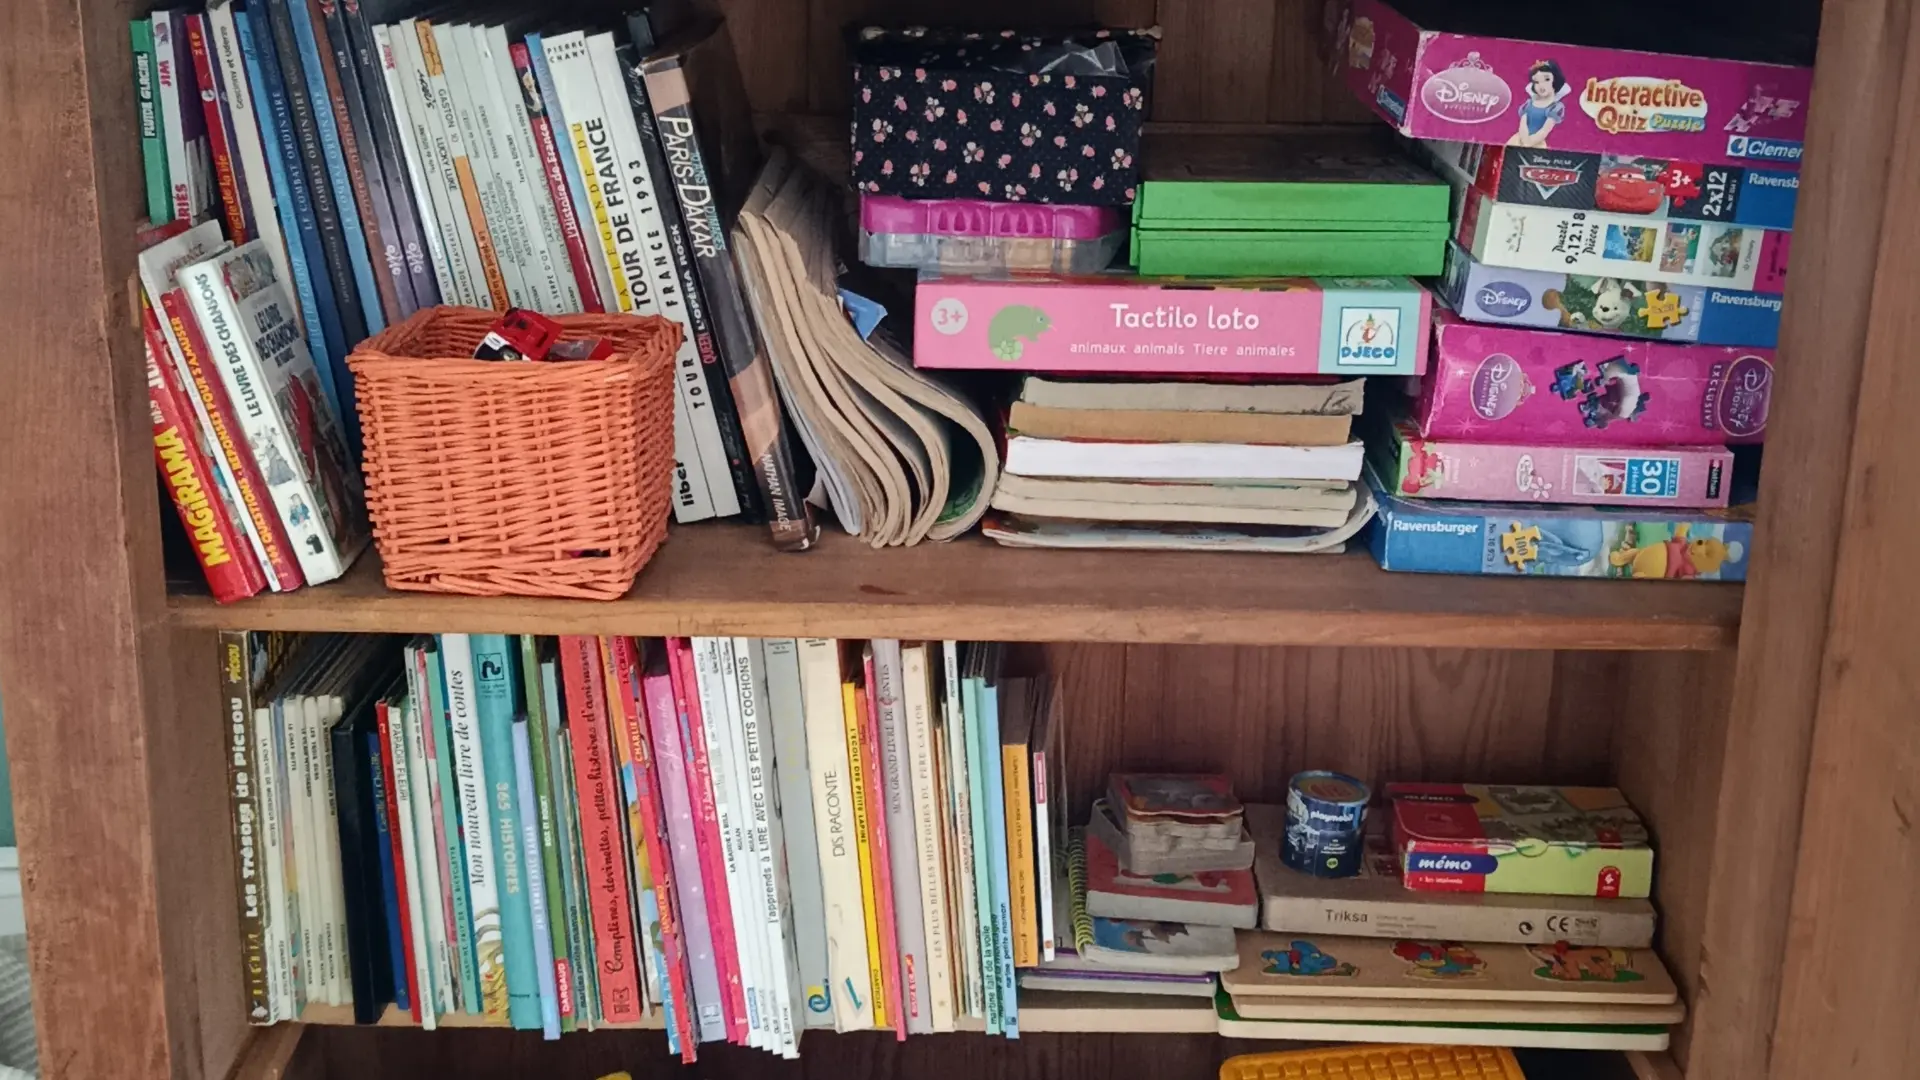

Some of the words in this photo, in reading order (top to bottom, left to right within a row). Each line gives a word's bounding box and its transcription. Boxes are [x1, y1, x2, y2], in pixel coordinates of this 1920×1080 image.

[219, 25, 231, 57] Uderzo
[547, 40, 583, 54] PIERRE
[549, 50, 584, 63] CHANY
[137, 52, 150, 99] GLACIAL
[158, 60, 171, 88] JIM
[226, 58, 234, 68] et
[229, 69, 244, 109] Goscinny
[1434, 78, 1500, 113] Disney
[1586, 79, 1702, 107] Interactive
[141, 101, 154, 136] FLUIDE
[273, 89, 294, 159] ORDINAIRE
[294, 89, 315, 159] ORDINAIRE
[314, 90, 335, 159] ORDINAIRE
[437, 88, 455, 128] GASTON
[1597, 106, 1648, 132] Quiz
[1652, 115, 1700, 132] Puzzle
[336, 94, 358, 164] ORDINAIRE
[536, 122, 558, 163] France
[572, 122, 586, 149] DU
[434, 136, 452, 166] LUCKY
[443, 167, 458, 192] LUKE
[548, 164, 563, 181] de
[587, 116, 621, 207] FRANCE
[291, 163, 306, 212] COMBAT
[311, 162, 327, 212] COMBAT
[331, 162, 349, 213] COMBAT
[355, 167, 371, 215] COMBAT
[628, 159, 652, 214] 1993
[659, 116, 716, 258] PARIS-DAKAR
[1670, 170, 1691, 188] 3+
[1702, 171, 1728, 217] 2x12
[1749, 172, 1800, 189] Ravensb
[303, 215, 311, 230] LE
[322, 216, 333, 230] LE
[554, 183, 580, 237] l'Histoire
[613, 212, 633, 244] DE
[669, 223, 688, 266] ROCK
[1552, 220, 1568, 253] Puzzle
[1565, 212, 1586, 264] 9.12.18
[623, 248, 649, 309] TOUR
[647, 228, 678, 307] FRANCE
[546, 274, 559, 299] SERPE
[618, 287, 632, 312] LA
[681, 269, 705, 330] L'OPÉRA
[196, 271, 229, 342] CHANSONS
[937, 308, 964, 326] 3+
[1110, 303, 1198, 331] Tactilo
[1208, 304, 1260, 331] loto
[222, 340, 240, 364] DES
[1070, 342, 1126, 355] animaux
[1133, 342, 1185, 356] animals
[1193, 343, 1228, 356] Tiere
[1236, 343, 1296, 357] animales
[1340, 345, 1397, 360] DJECO
[233, 364, 254, 402] LIVRE
[682, 357, 704, 408] TOUR
[1480, 357, 1510, 417] Disney
[1701, 363, 1723, 427] EXCLUSIVE
[246, 400, 262, 418] LE
[672, 460, 694, 507] liber
[759, 452, 782, 497] NATHAN
[771, 496, 791, 533] IMAGE
[1640, 460, 1661, 494] 30
[1668, 461, 1676, 495] PUZZLE
[153, 425, 231, 568] MAGIRAMA
[1393, 520, 1479, 536] Ravensburger
[1514, 535, 1526, 557] 100
[449, 668, 467, 718] contes
[738, 655, 754, 716] COCHONS
[875, 663, 896, 705] CONTES
[229, 696, 246, 765] Picsou
[453, 720, 470, 740] de
[883, 708, 893, 721] DE
[913, 704, 925, 748] CASTOR
[582, 726, 600, 780] histoires
[745, 721, 758, 761] PETITS
[885, 725, 895, 753] LIVRE
[456, 742, 475, 780] livre
[750, 766, 760, 788] LES
[888, 754, 899, 790] GRAND
[235, 771, 248, 797] de
[495, 781, 510, 811] 365
[591, 781, 609, 821] petites
[921, 785, 928, 798] DU
[461, 782, 483, 850] nouveau
[753, 792, 764, 822] AVEC
[823, 770, 843, 833] RACONTE
[891, 792, 901, 814] MON
[1310, 810, 1354, 822] playmobil
[721, 812, 729, 828] BILL
[922, 803, 934, 861] HISTOIRES
[498, 816, 521, 894] HISTOIRES
[735, 827, 743, 850] MULAN
[758, 827, 768, 850] LIRE
[831, 835, 844, 857] DIS
[466, 853, 485, 888] Mon
[596, 825, 616, 893] devinettes,
[728, 863, 735, 873] LA
[1418, 855, 1472, 871] mémo
[244, 883, 257, 917] Les
[927, 865, 937, 904] BELLES
[566, 904, 581, 943] maman
[931, 908, 939, 935] PLUS
[999, 903, 1007, 933] maman
[1325, 909, 1368, 924] Triksa
[597, 895, 624, 974] Comptines,
[934, 939, 942, 958] LES
[980, 925, 990, 947] voile
[1002, 936, 1010, 959] petite
[982, 949, 991, 957] la
[983, 960, 992, 972] de
[556, 962, 571, 1013] DARGAUD
[1004, 963, 1012, 987] martine
[988, 992, 996, 1024] martine
